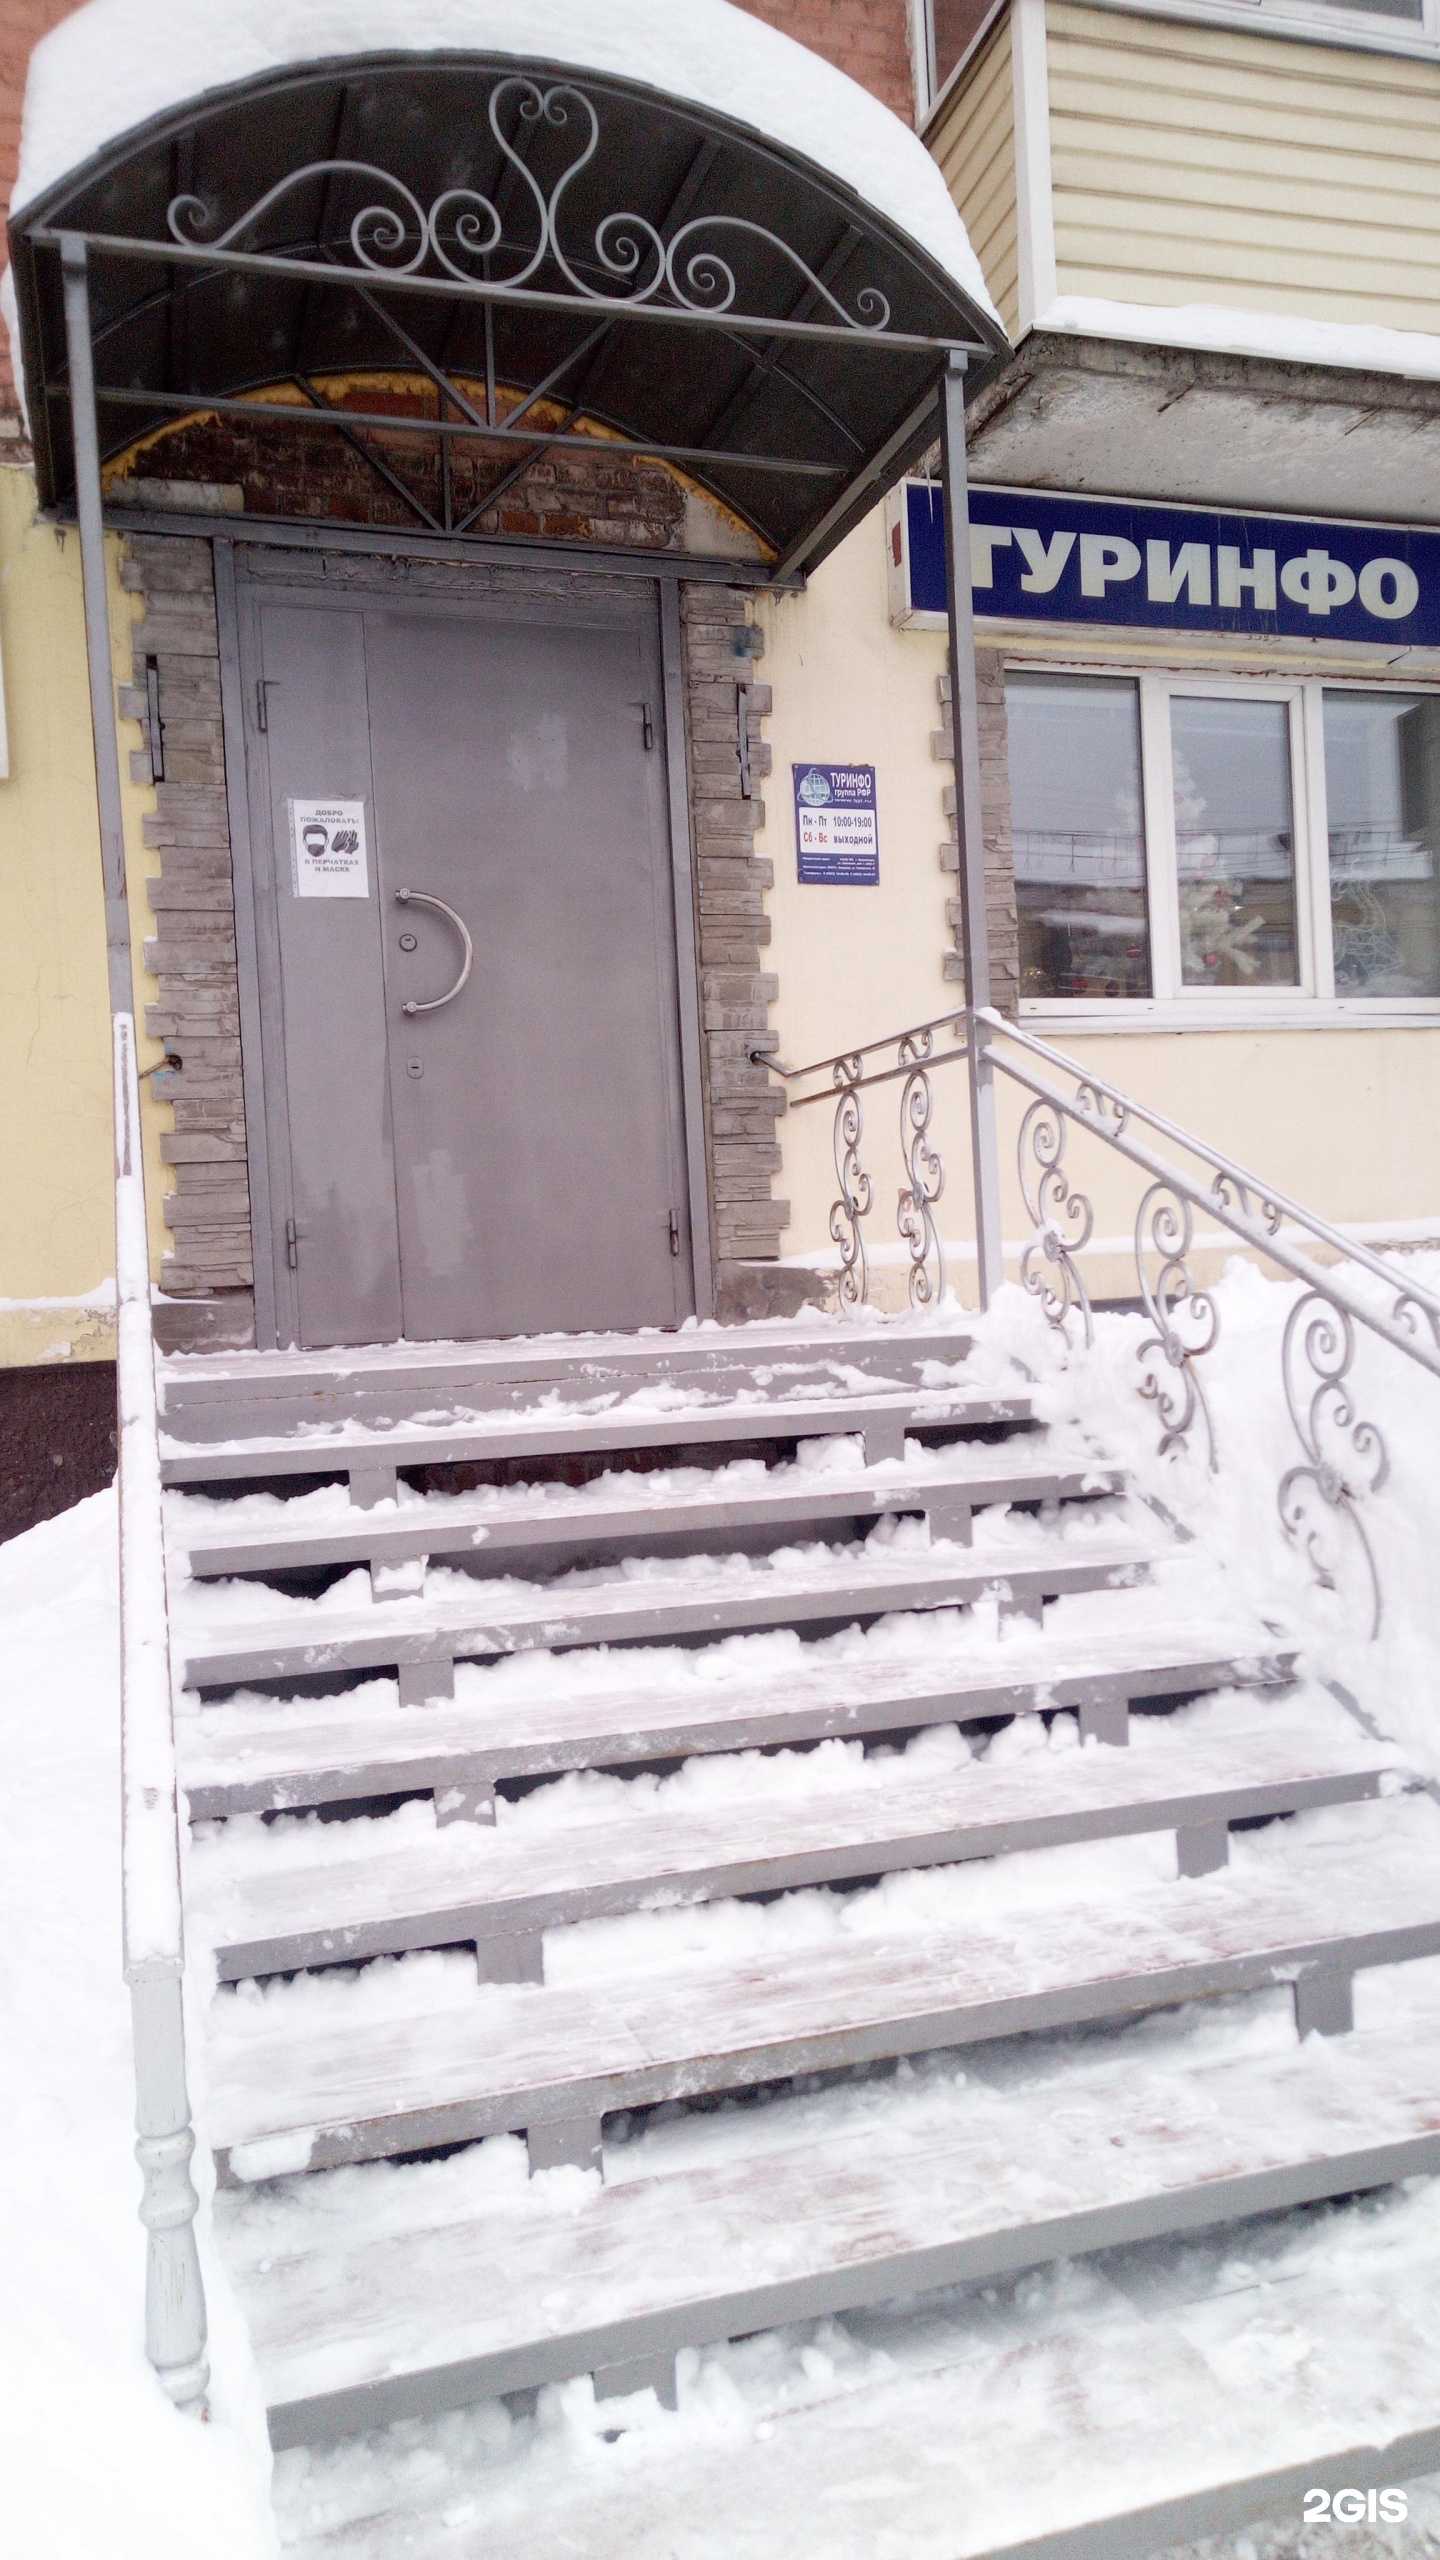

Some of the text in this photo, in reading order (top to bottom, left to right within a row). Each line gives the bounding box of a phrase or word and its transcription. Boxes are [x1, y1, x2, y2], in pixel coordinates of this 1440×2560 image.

[968, 523, 1419, 620] ТУРИНФО
[830, 772, 872, 788] ТУРИНФО
[834, 789, 856, 798] группа
[802, 815, 813, 825] Пн
[818, 815, 827, 826] Пт
[833, 816, 872, 827] 10:00-19:00
[803, 832, 813, 842] Сб
[818, 832, 828, 843] Вс
[833, 834, 873, 844] выходной
